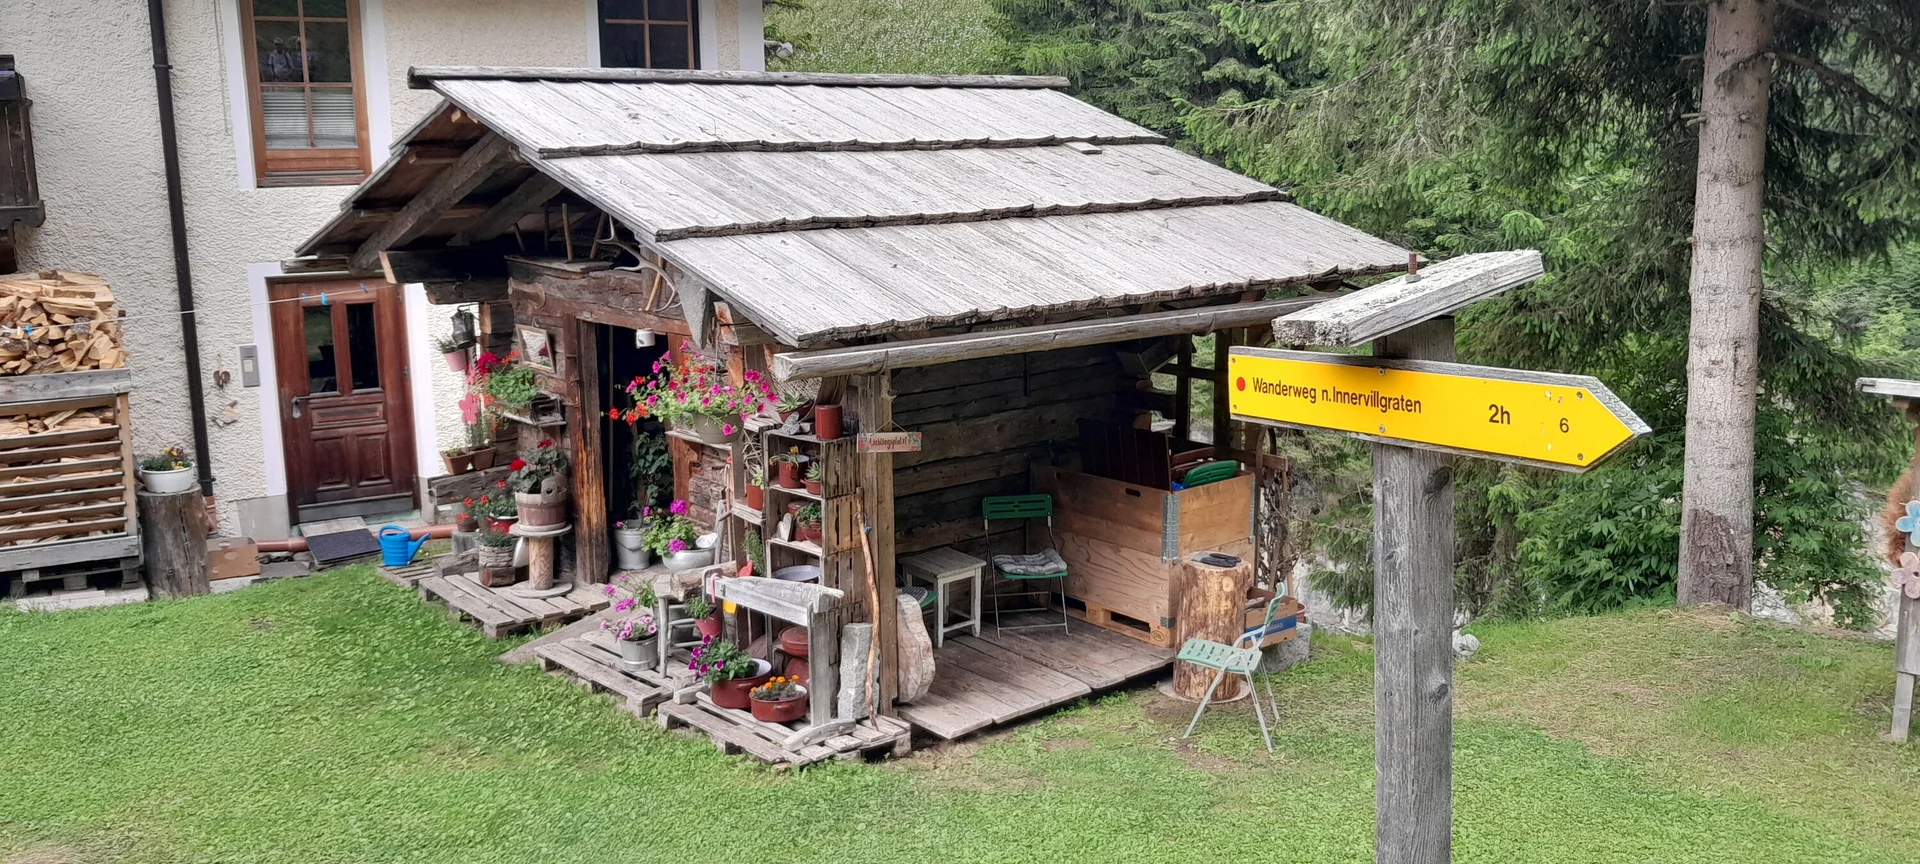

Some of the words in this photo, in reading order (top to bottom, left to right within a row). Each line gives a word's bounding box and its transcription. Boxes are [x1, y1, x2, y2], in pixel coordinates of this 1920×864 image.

[1252, 377, 1316, 403] Wanderweg
[1488, 403, 1511, 425] 2h
[1559, 417, 1570, 434] 6
